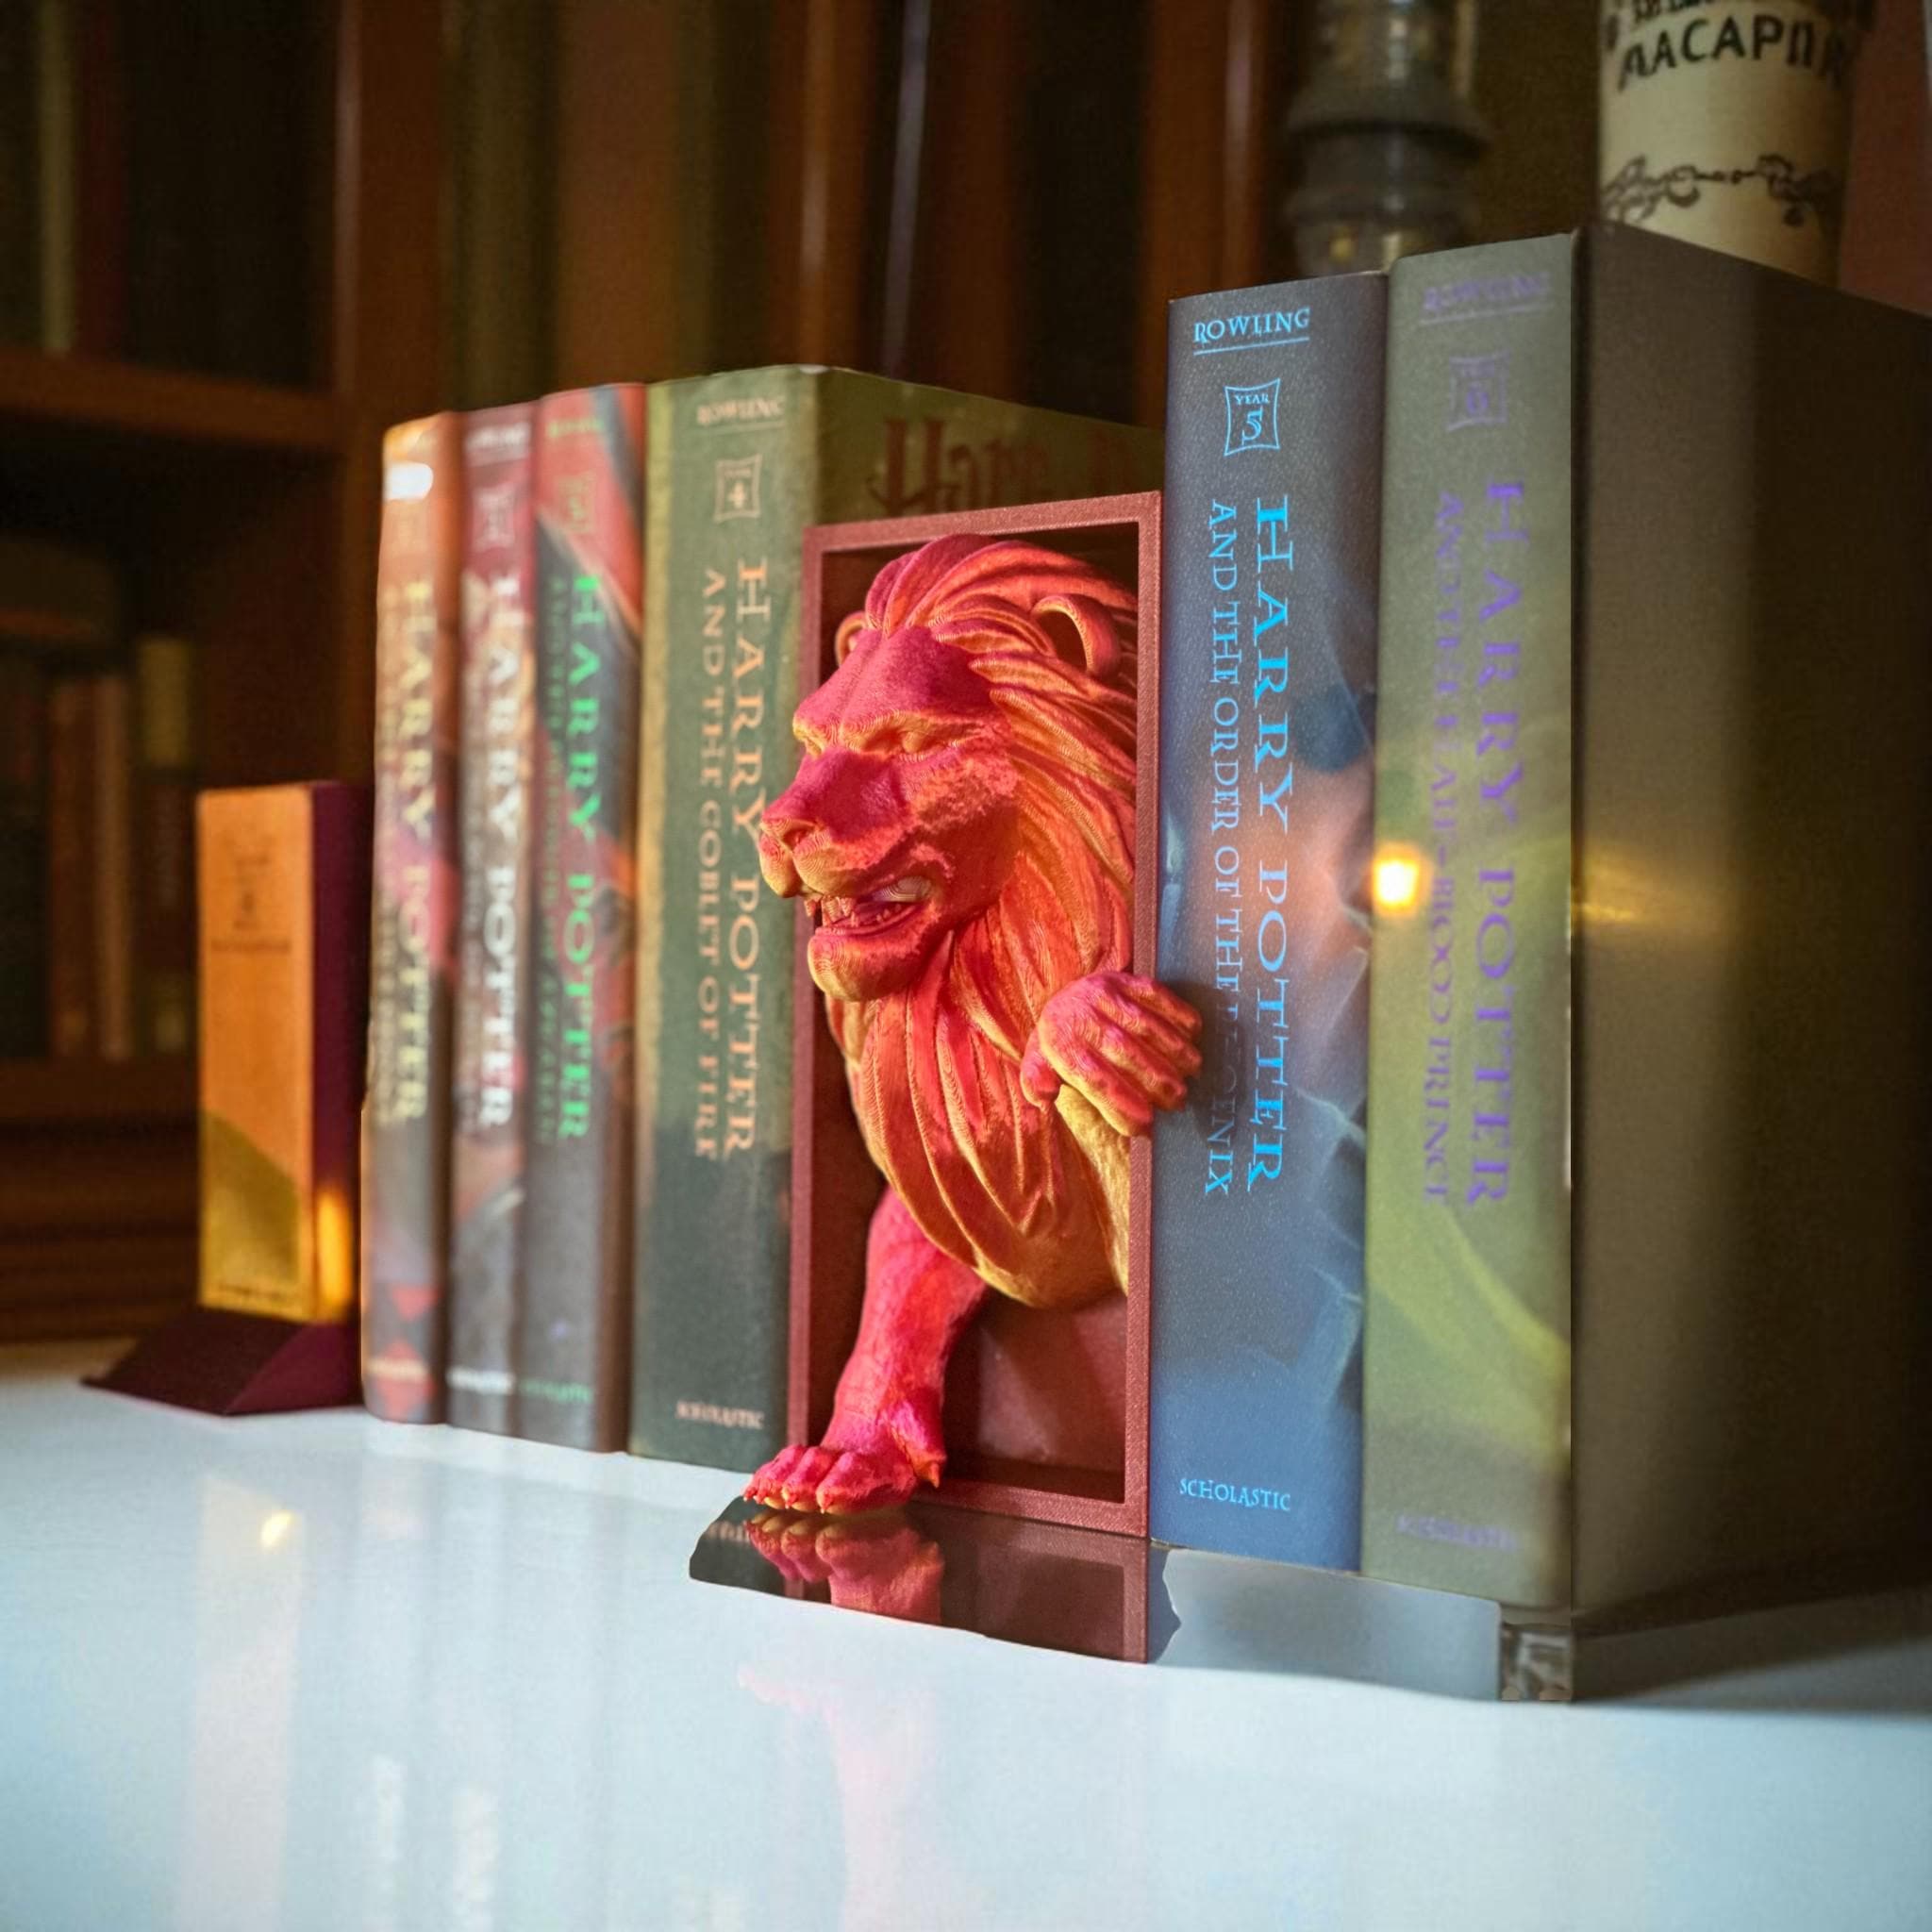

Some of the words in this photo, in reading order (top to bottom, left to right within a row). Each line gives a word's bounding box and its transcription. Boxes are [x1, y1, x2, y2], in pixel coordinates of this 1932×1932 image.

[1193, 307, 1310, 348] ROWLING
[1234, 393, 1270, 406] YEAR
[1241, 406, 1264, 446] 5
[702, 568, 726, 675] AND
[1208, 499, 1238, 591] AND
[1210, 601, 1241, 685] THE
[399, 578, 438, 841] HARRY
[487, 575, 530, 844] HARRY
[568, 575, 605, 841] HARRY
[700, 685, 726, 789] THE
[729, 558, 772, 849] HARRY
[1253, 494, 1293, 835] HARRY
[1477, 480, 1530, 824] HARRY
[1210, 697, 1241, 835] ORDER
[1214, 845, 1243, 898] OF
[1215, 908, 1243, 992] THE
[391, 864, 433, 1122] POTTER
[479, 865, 518, 1126] POTTER
[558, 873, 596, 1138] POTTER
[697, 976, 723, 1040] OF
[723, 874, 760, 1160] POTTER
[1247, 859, 1290, 1191] POTTER
[1466, 865, 1517, 1206] POTTER
[1179, 1478, 1291, 1511] SCHOLASTIC
